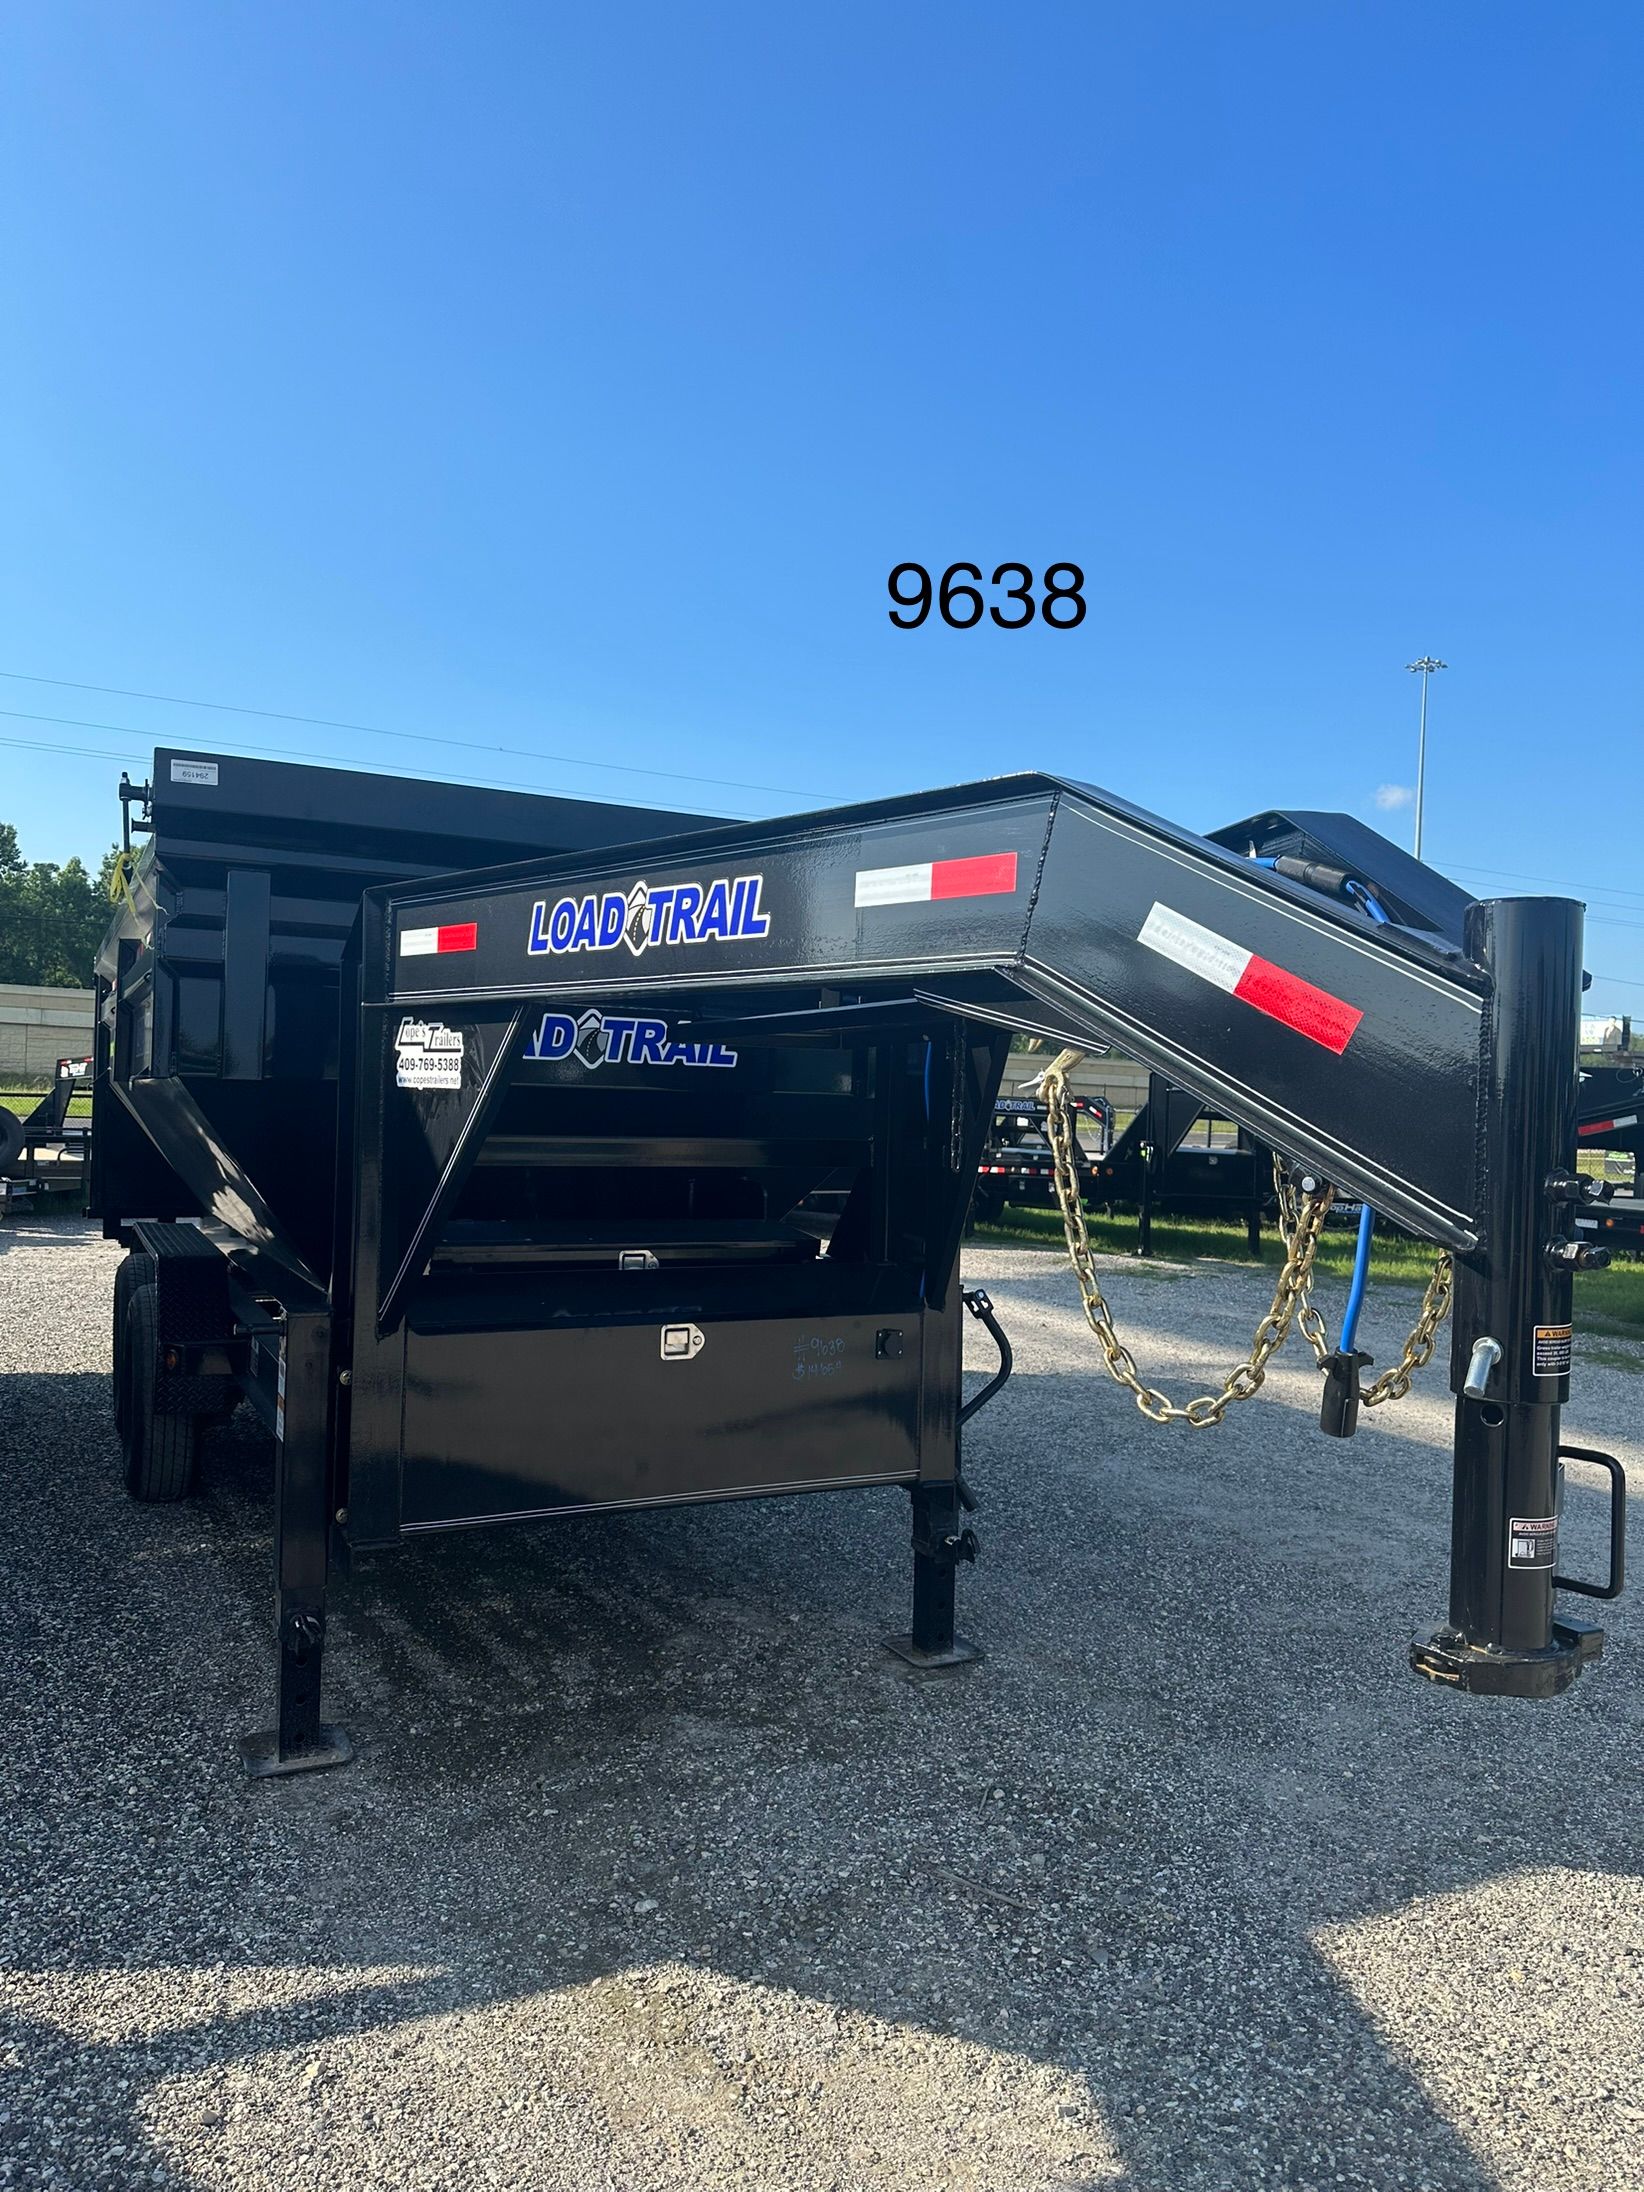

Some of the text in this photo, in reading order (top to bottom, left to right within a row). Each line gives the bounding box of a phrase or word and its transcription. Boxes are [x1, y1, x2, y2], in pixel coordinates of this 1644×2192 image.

[528, 875, 771, 955] LOAD TRAIL
[399, 1058, 459, 1071] 409-769-5388
